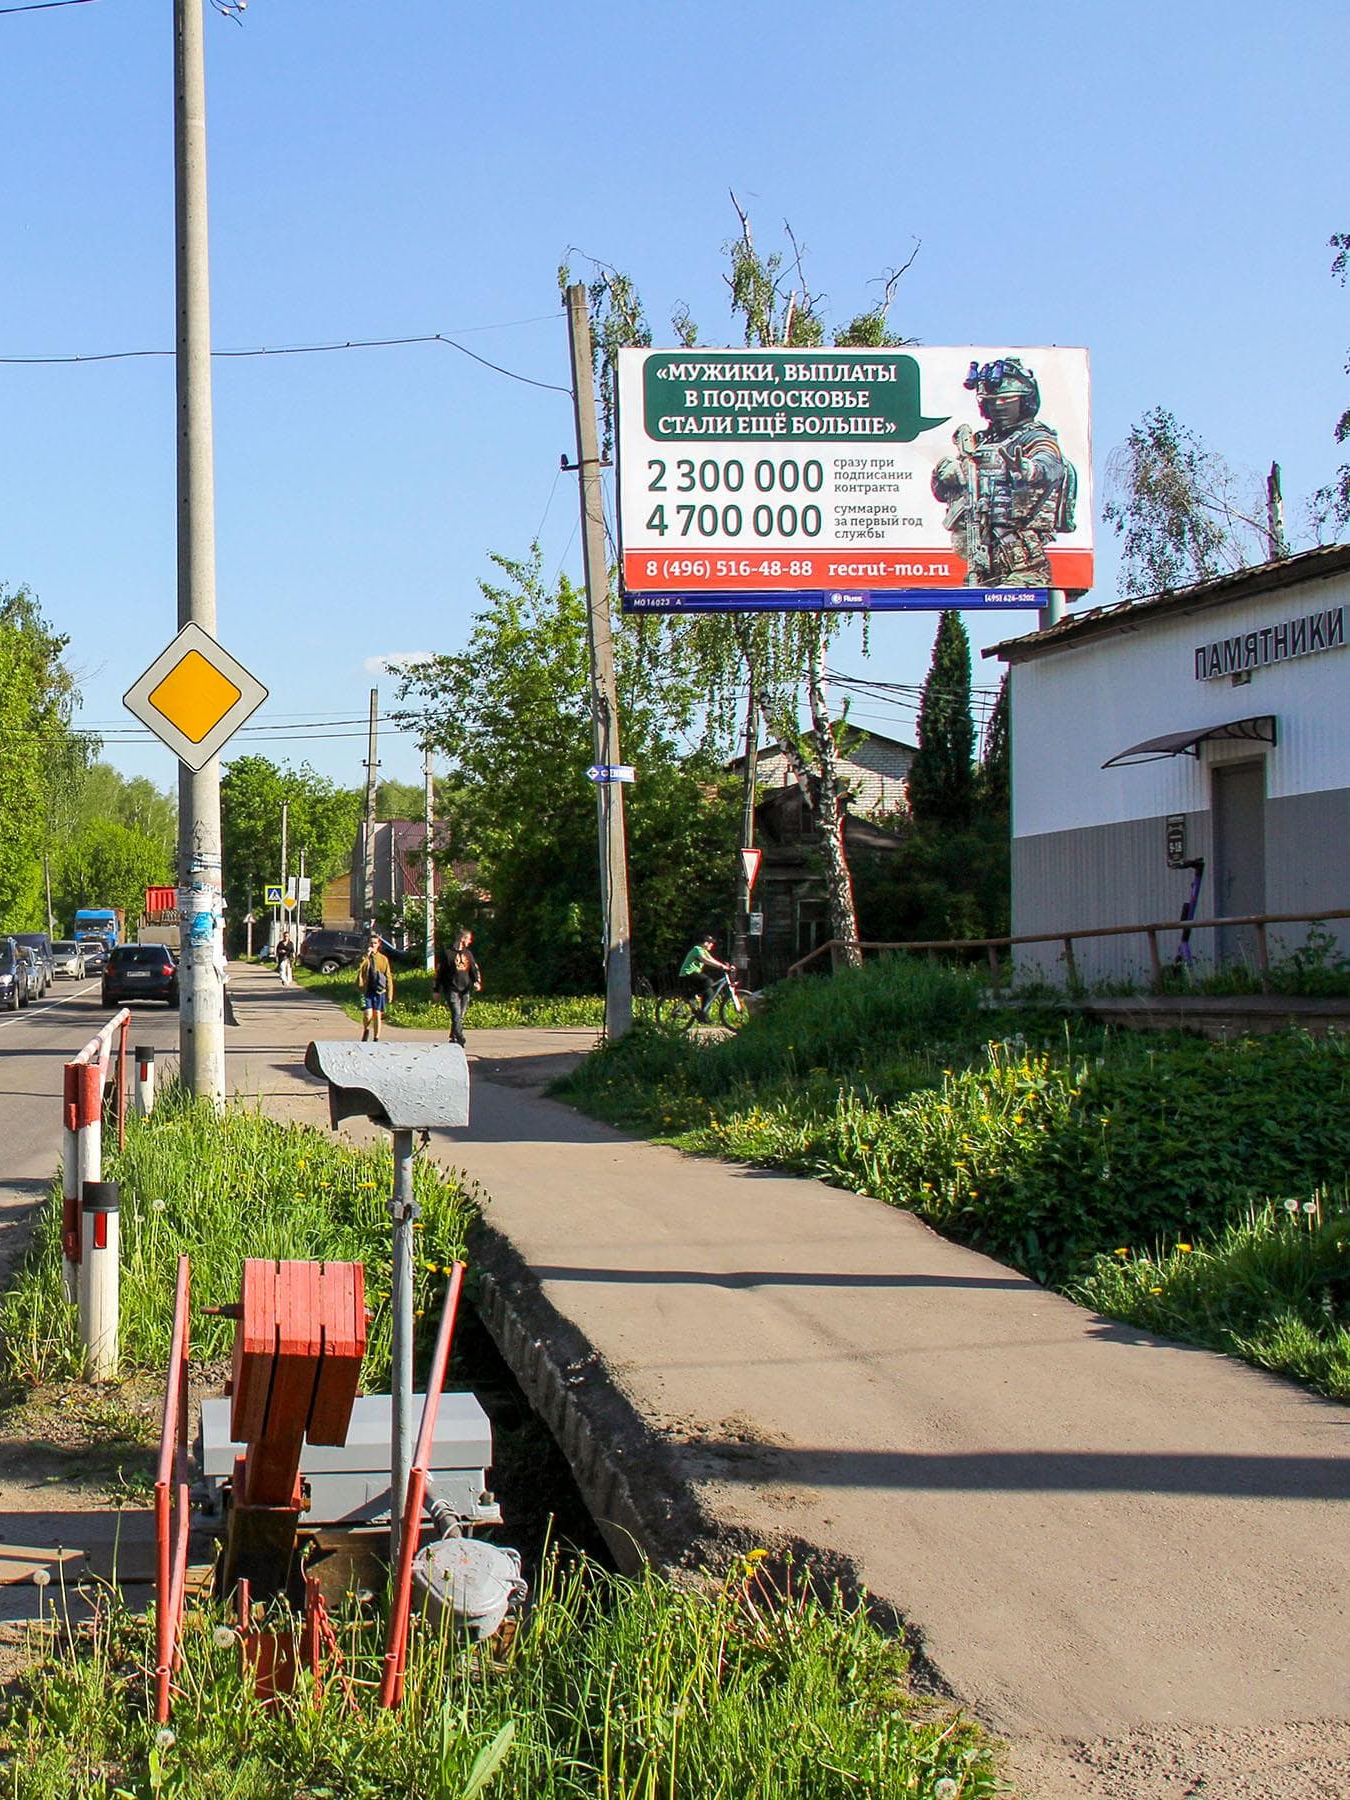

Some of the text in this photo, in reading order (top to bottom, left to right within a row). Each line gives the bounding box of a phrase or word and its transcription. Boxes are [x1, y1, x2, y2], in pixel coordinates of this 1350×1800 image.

[656, 363, 898, 384] «МУЖИКИ, ВЫПЛАТЫ
[684, 390, 870, 412] В ПОДМОСКОВЬЕ
[658, 412, 897, 437] СТАЛИ ЕЩЁ БОЛЬШЕ»
[834, 459, 895, 470] сразу при
[754, 459, 824, 493] 000
[834, 471, 913, 482] подписании
[834, 484, 900, 494] контракта
[834, 505, 898, 517] суммарно
[753, 504, 822, 538] 000
[834, 515, 923, 530] за первый год
[834, 529, 885, 541] службы
[646, 560, 813, 580] 8 (496) 516-48-88
[828, 561, 950, 577] recrut-mo.ru
[1195, 606, 1345, 680] ПАМЯТНИКИ
